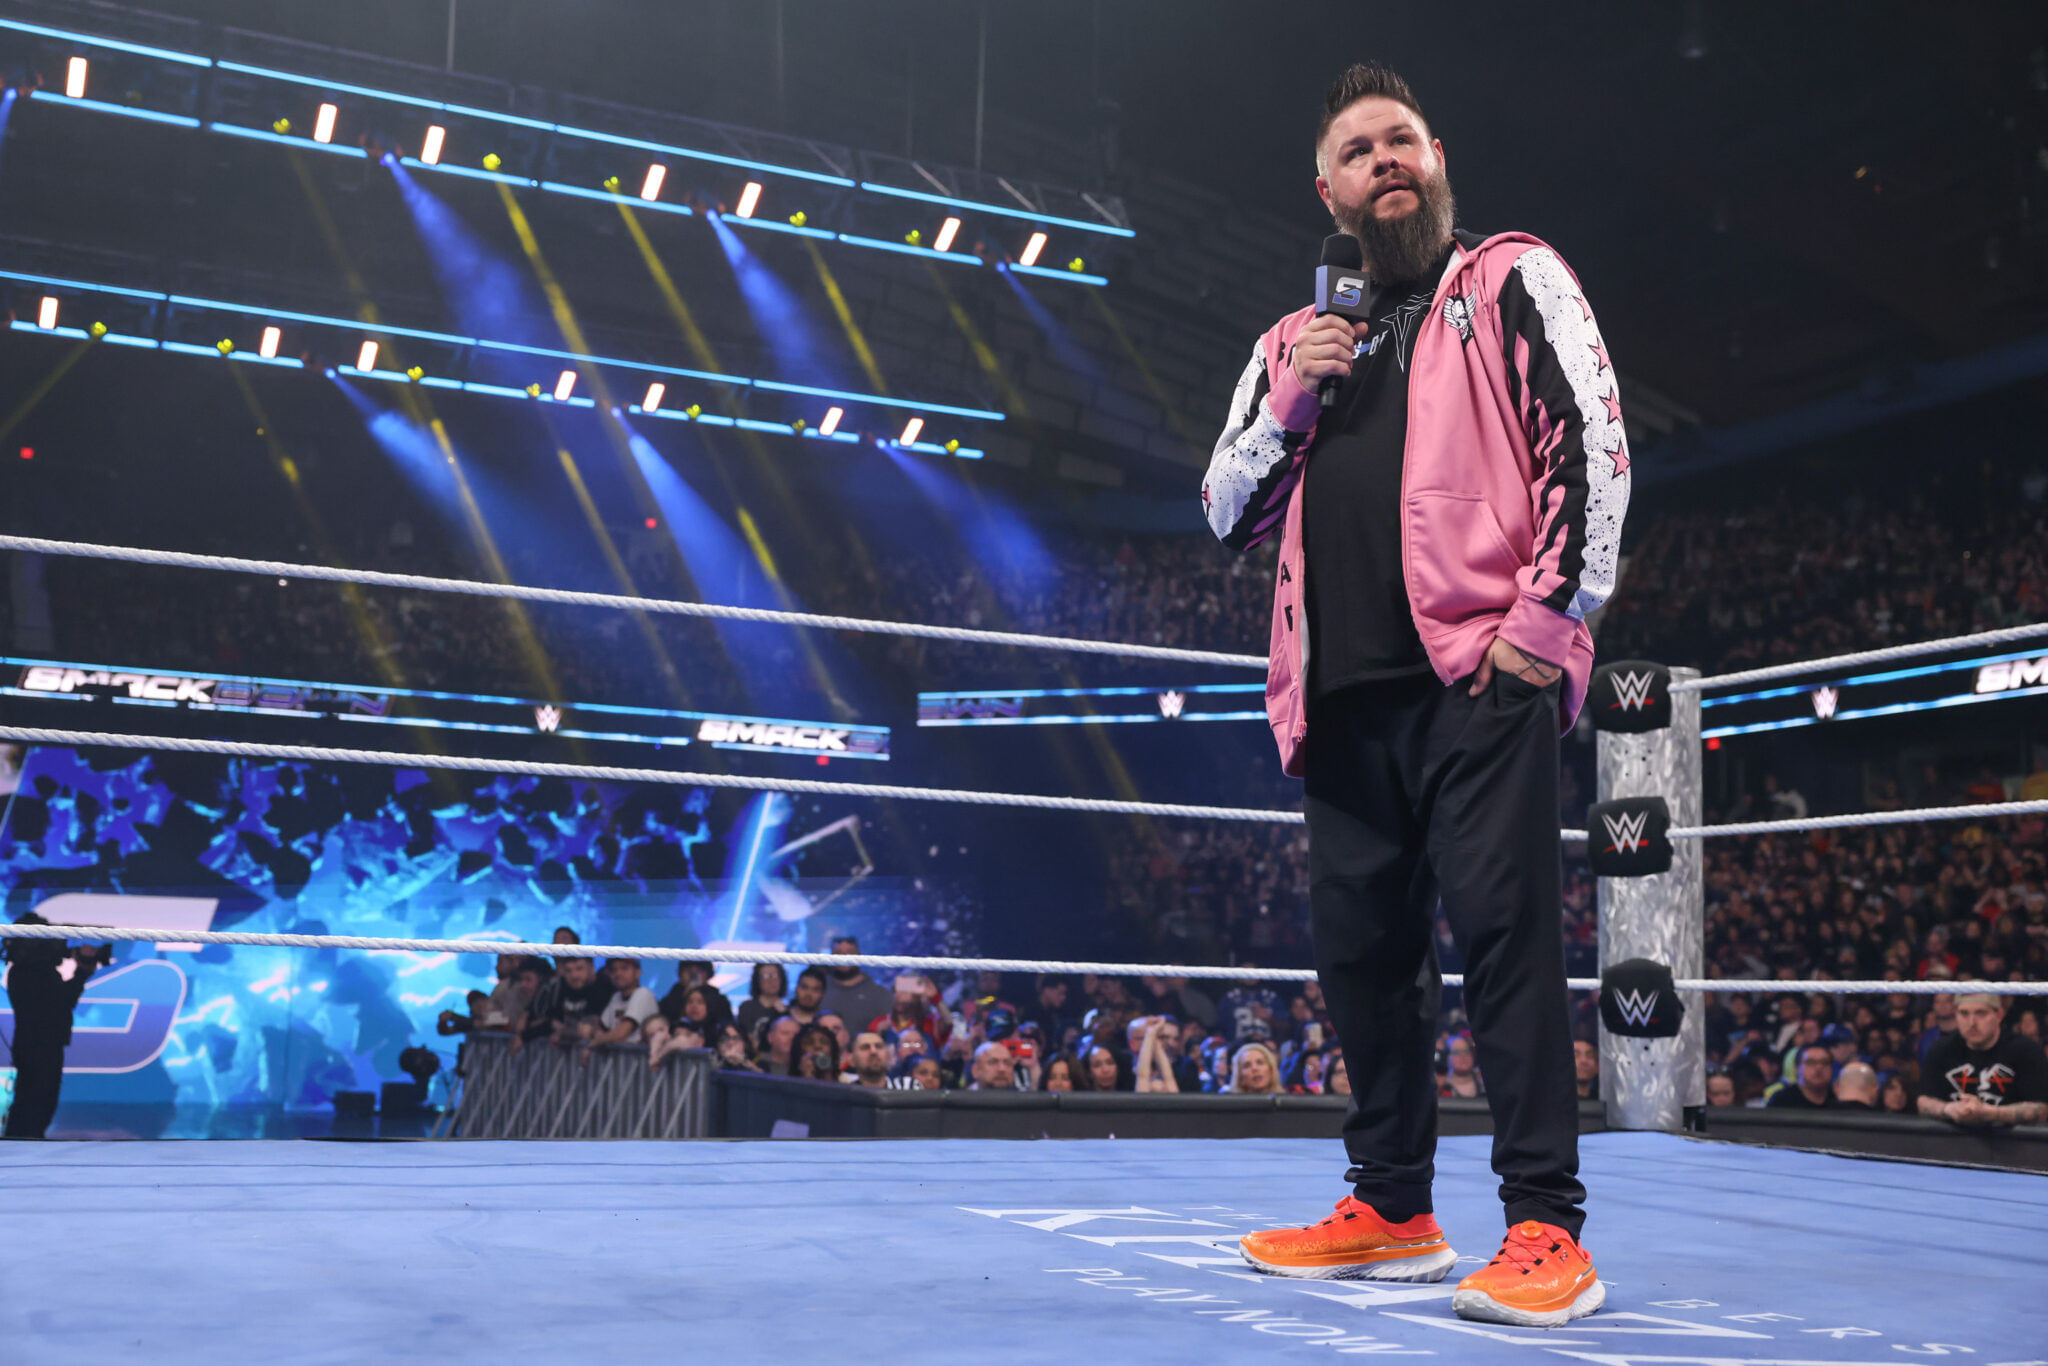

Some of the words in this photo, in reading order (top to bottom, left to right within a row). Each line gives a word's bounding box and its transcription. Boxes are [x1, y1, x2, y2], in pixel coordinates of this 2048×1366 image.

[1332, 276, 1364, 307] S
[1043, 1268, 1241, 1304] PLAY
[1194, 1309, 1440, 1355] NOW
[1645, 1298, 2048, 1366] BERS
